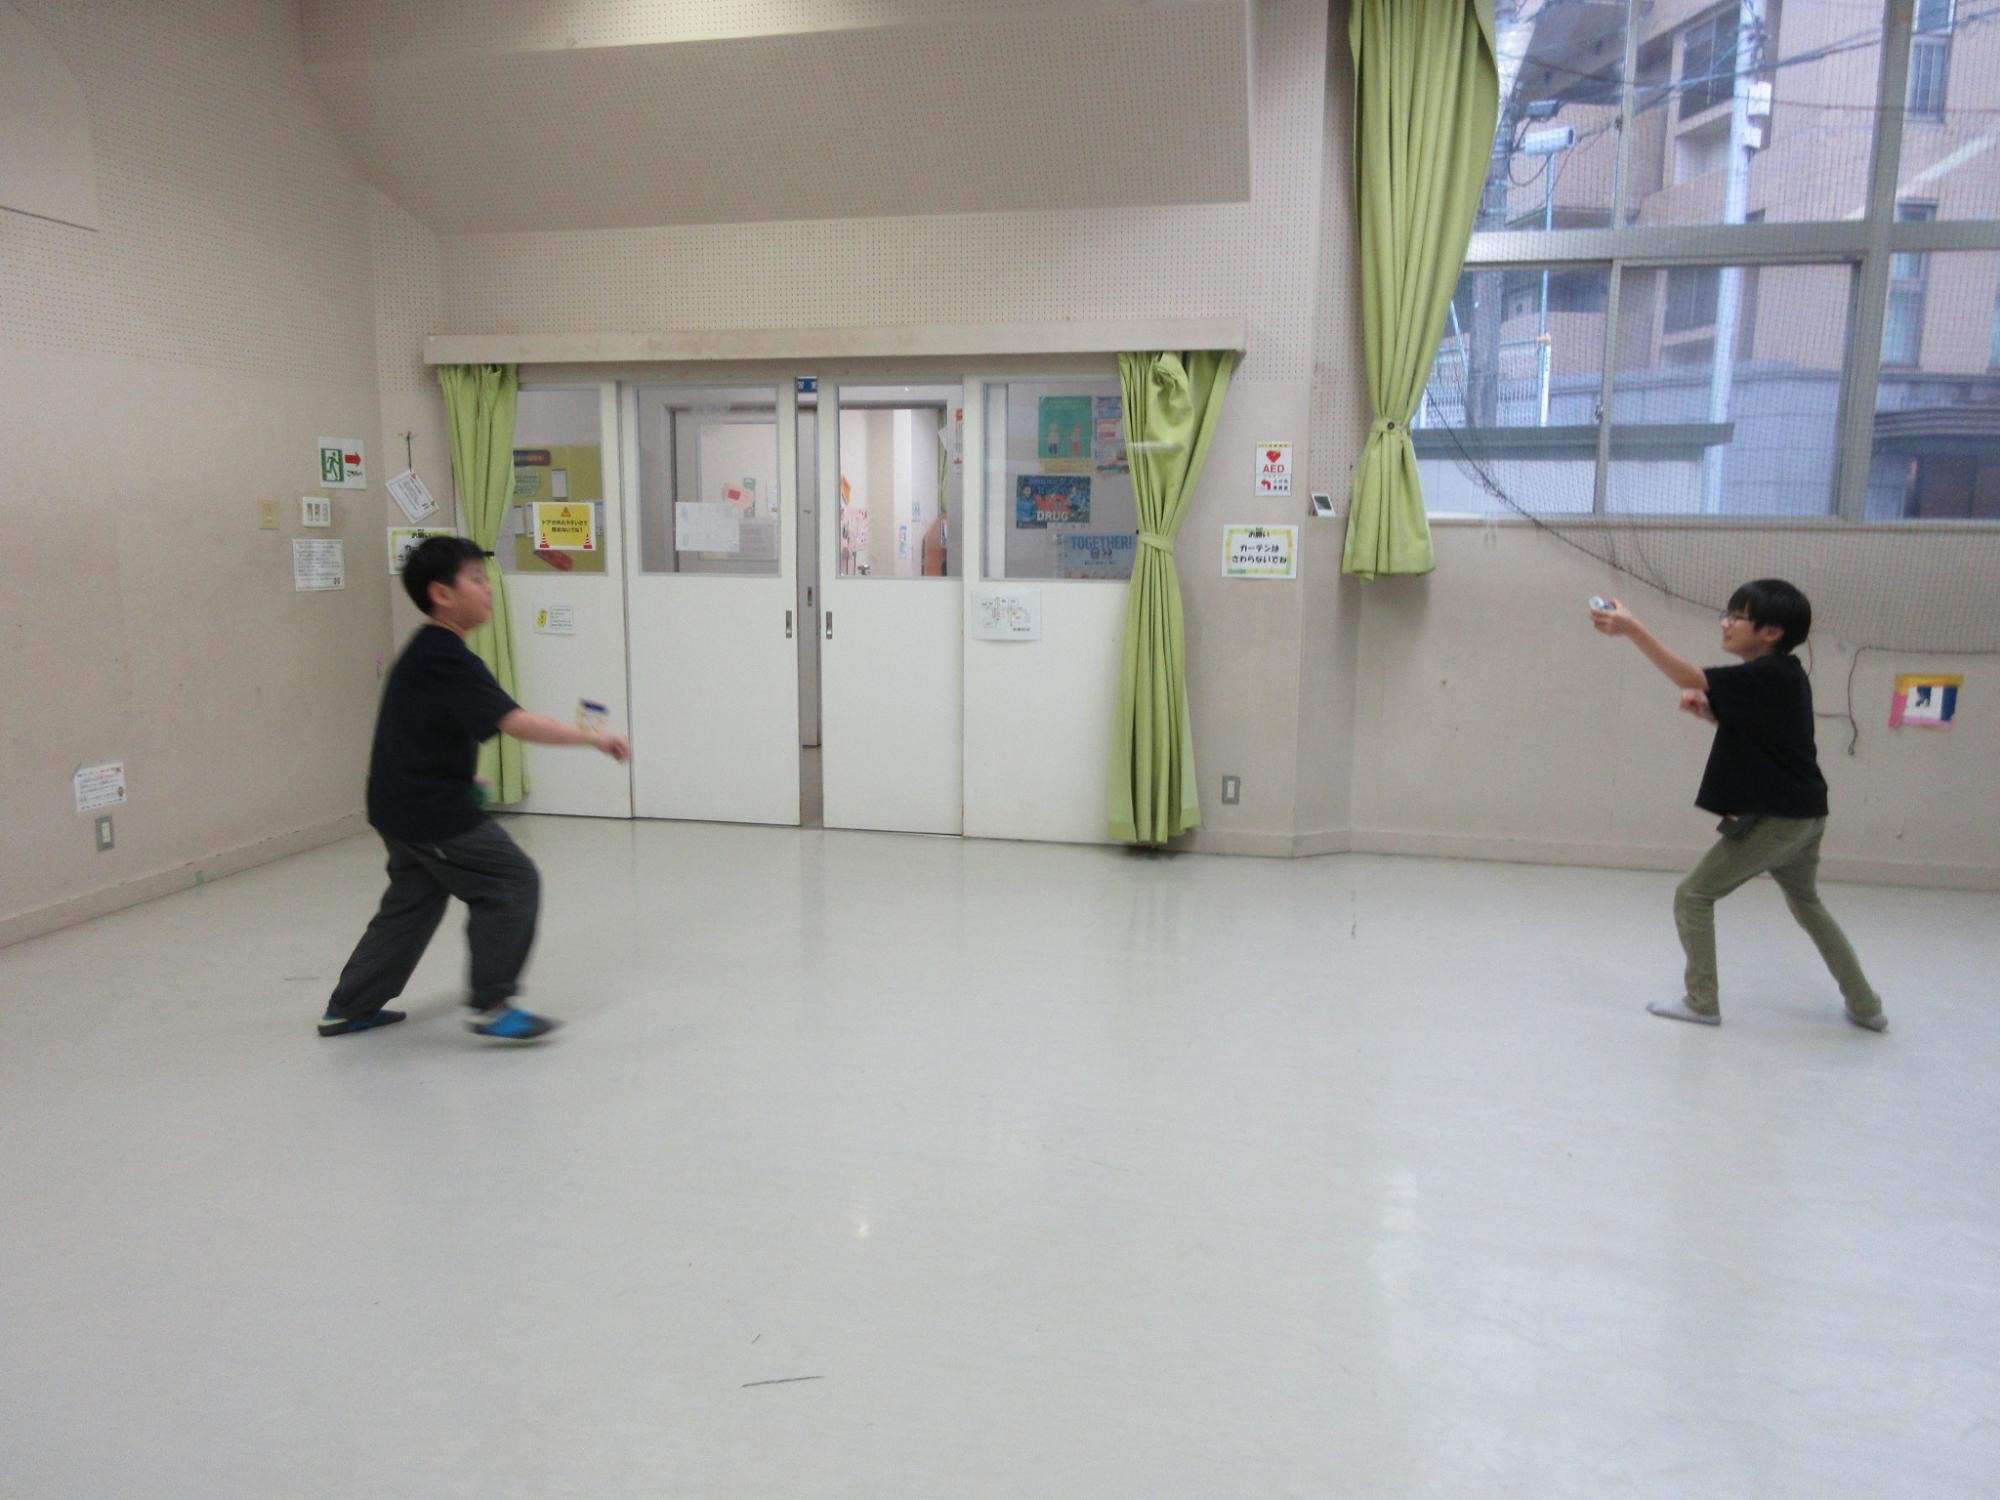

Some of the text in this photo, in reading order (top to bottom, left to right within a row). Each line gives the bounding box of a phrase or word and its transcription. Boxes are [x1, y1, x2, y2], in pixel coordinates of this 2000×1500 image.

[1262, 464, 1285, 473] AED
[1036, 510, 1069, 521] DRUG
[1071, 535, 1132, 550] TOGETHER!
[1240, 544, 1279, 553] カーテンは
[1232, 555, 1287, 564] さわらないでね
